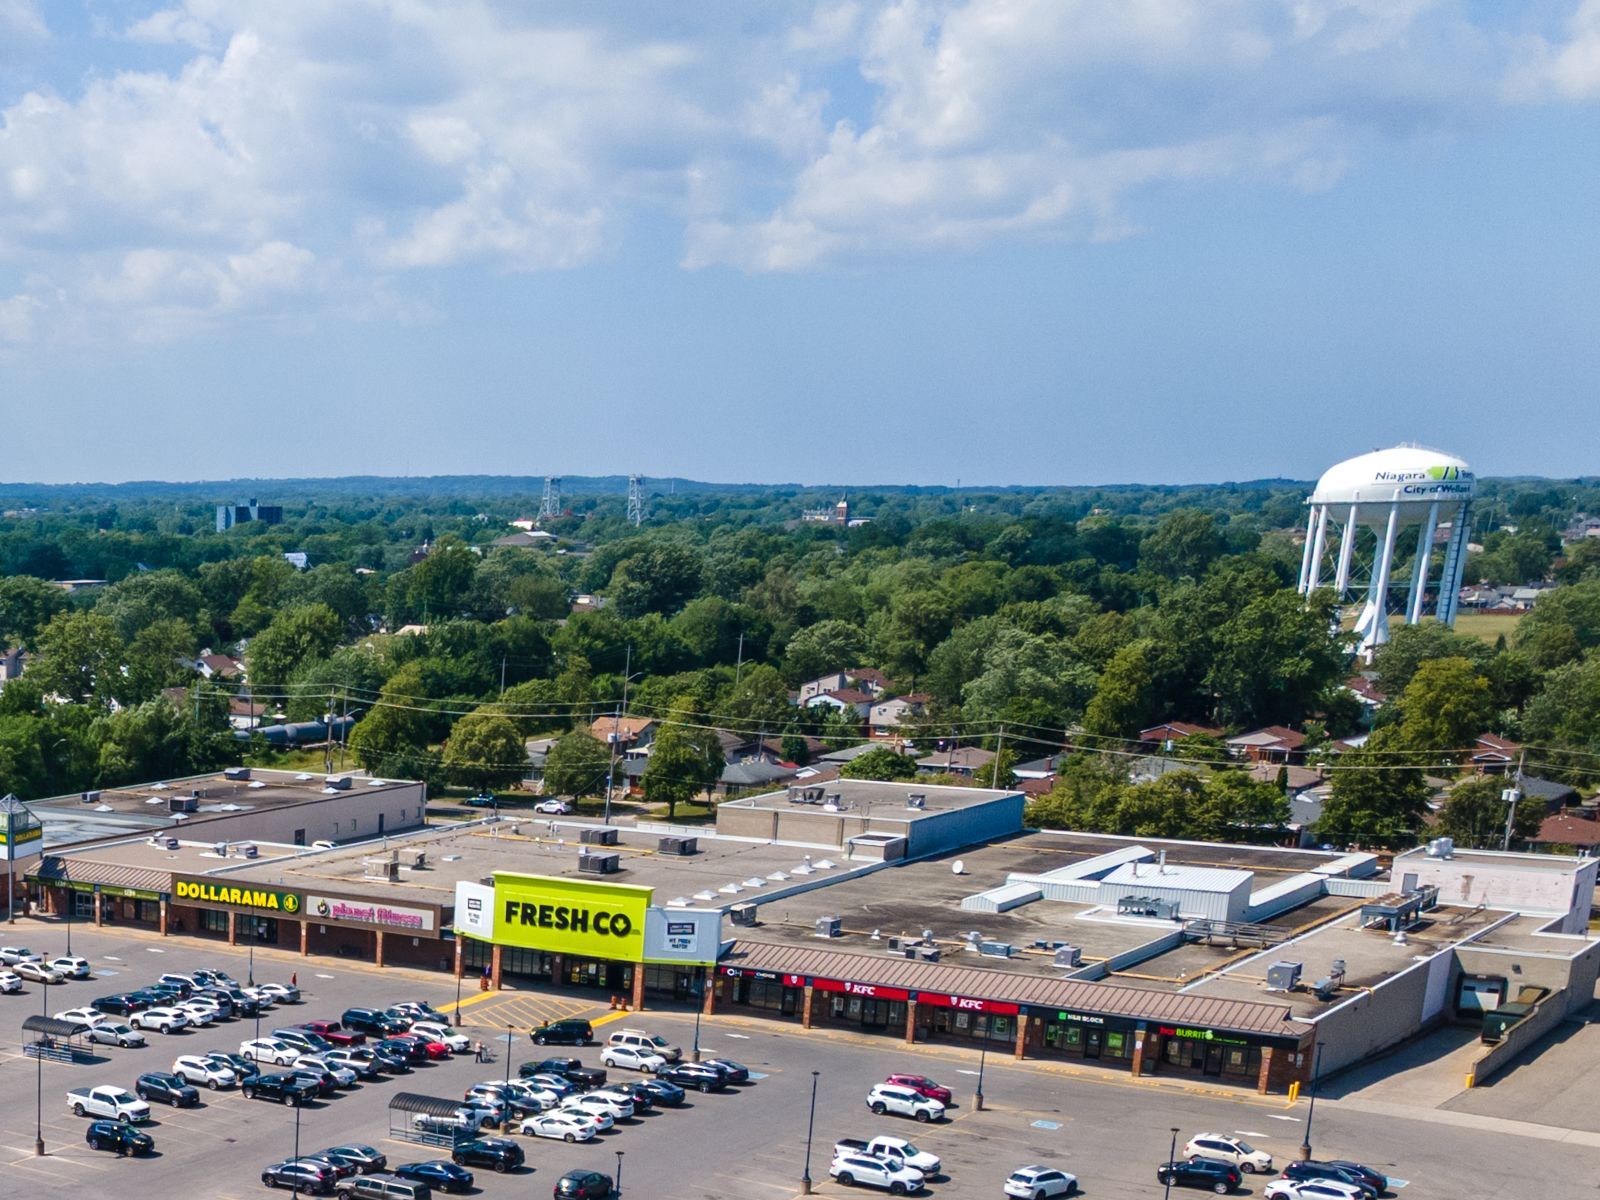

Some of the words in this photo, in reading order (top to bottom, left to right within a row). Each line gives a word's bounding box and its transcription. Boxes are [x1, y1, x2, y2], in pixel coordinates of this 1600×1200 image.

[1375, 471, 1426, 482] Niagara
[1403, 485, 1426, 495] City
[1429, 484, 1441, 493] of
[177, 882, 279, 909] DOLLARAMA
[332, 903, 374, 919] planet
[377, 908, 422, 926] fitness
[852, 984, 875, 996] KFC
[959, 998, 984, 1010] KFC
